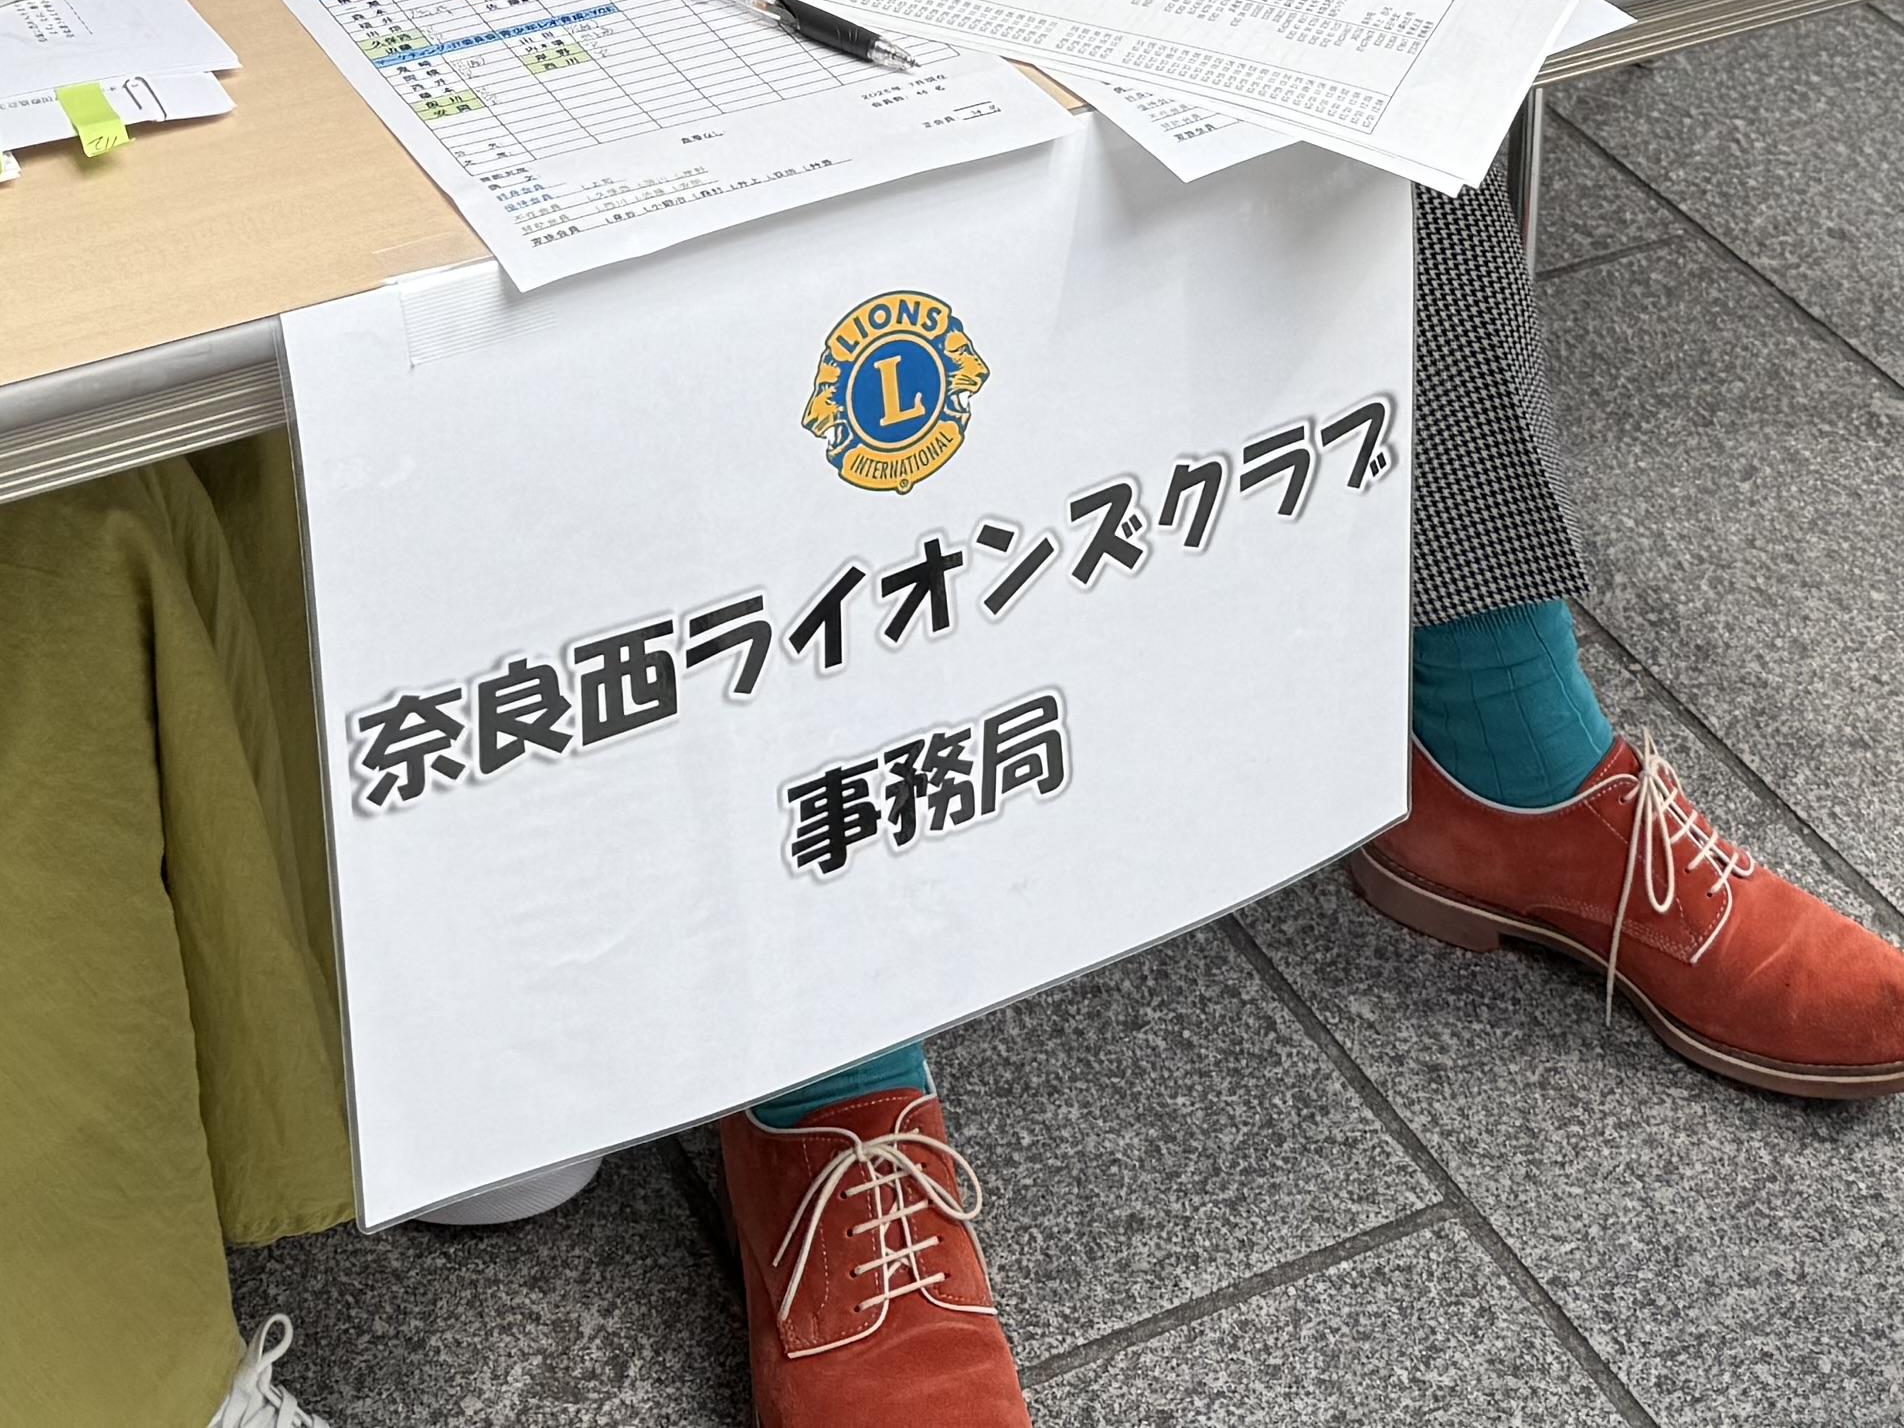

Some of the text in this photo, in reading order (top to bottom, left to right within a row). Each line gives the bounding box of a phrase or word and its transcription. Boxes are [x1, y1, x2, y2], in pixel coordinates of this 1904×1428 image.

[836, 299, 942, 355] LIONS
[873, 354, 926, 427] L
[849, 430, 954, 481] INTERNATIONAL
[358, 400, 1393, 809] 奈良西ライオンズクラブ
[786, 693, 1066, 875] 事務局
